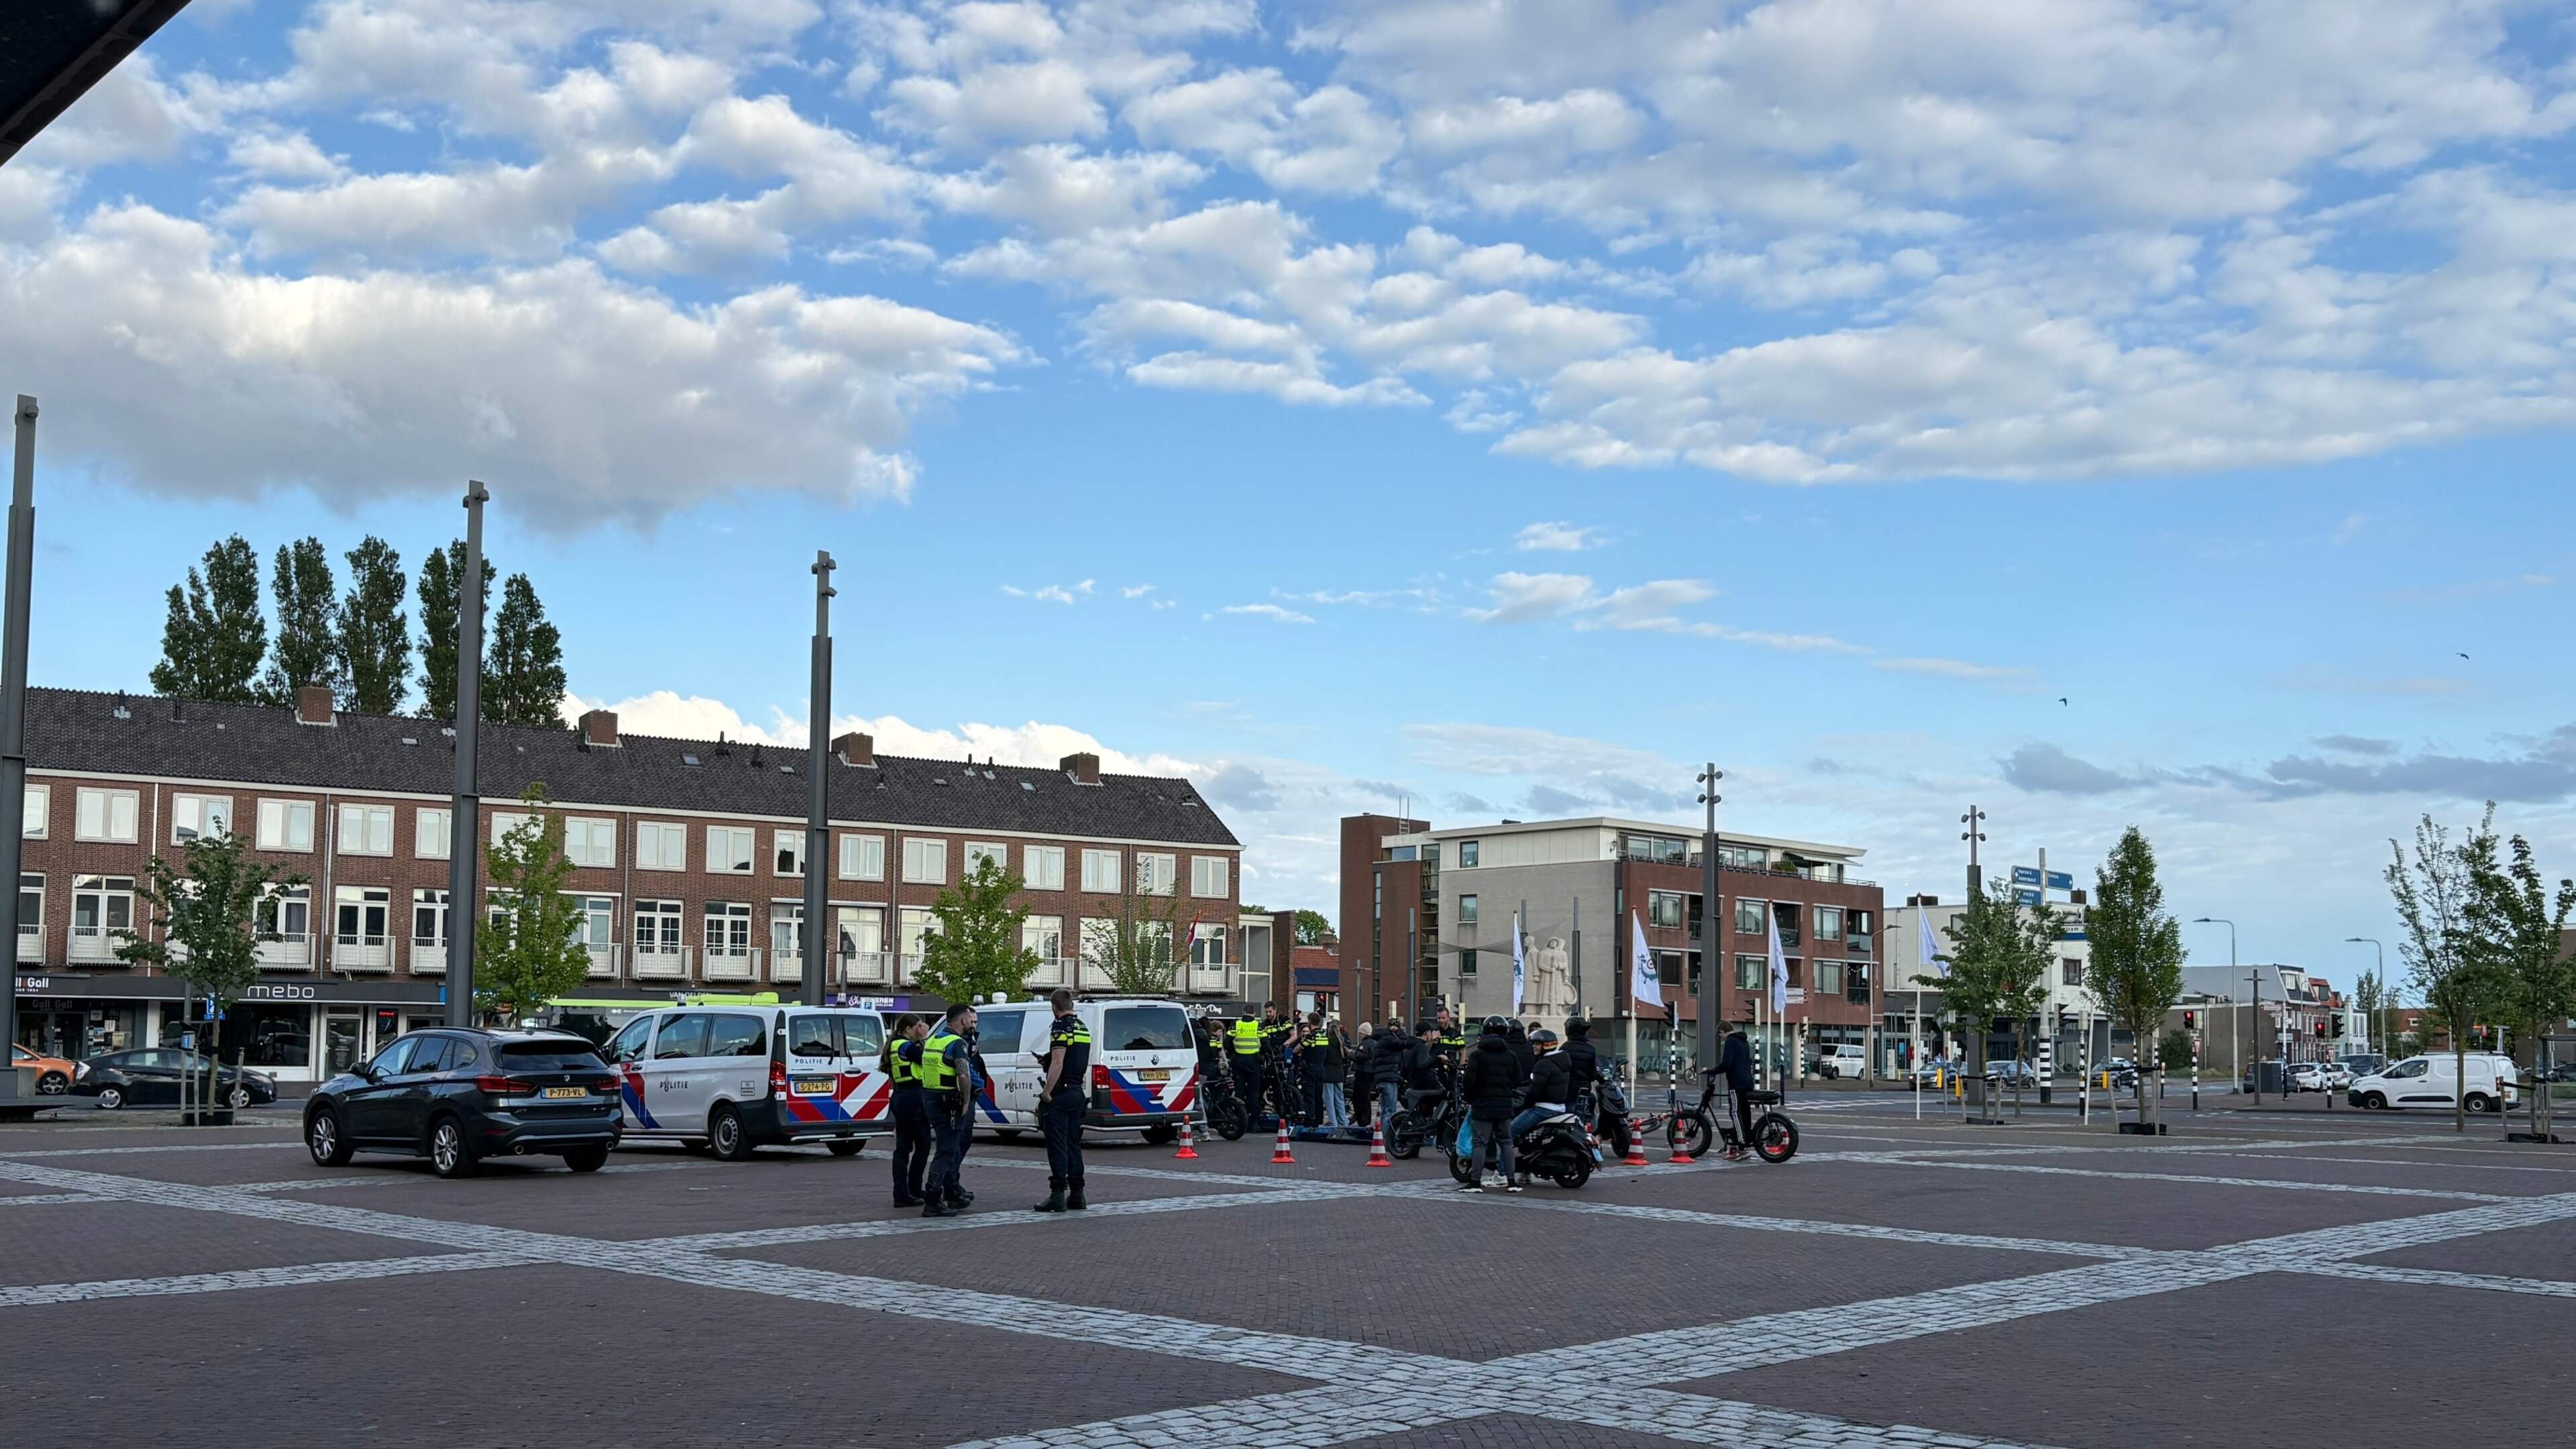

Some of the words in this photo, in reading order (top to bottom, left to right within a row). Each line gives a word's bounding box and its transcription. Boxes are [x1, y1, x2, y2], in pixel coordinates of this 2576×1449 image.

[27, 977, 49, 988] Gall
[248, 983, 315, 998] mebo
[549, 1088, 582, 1096] P-773-VL
